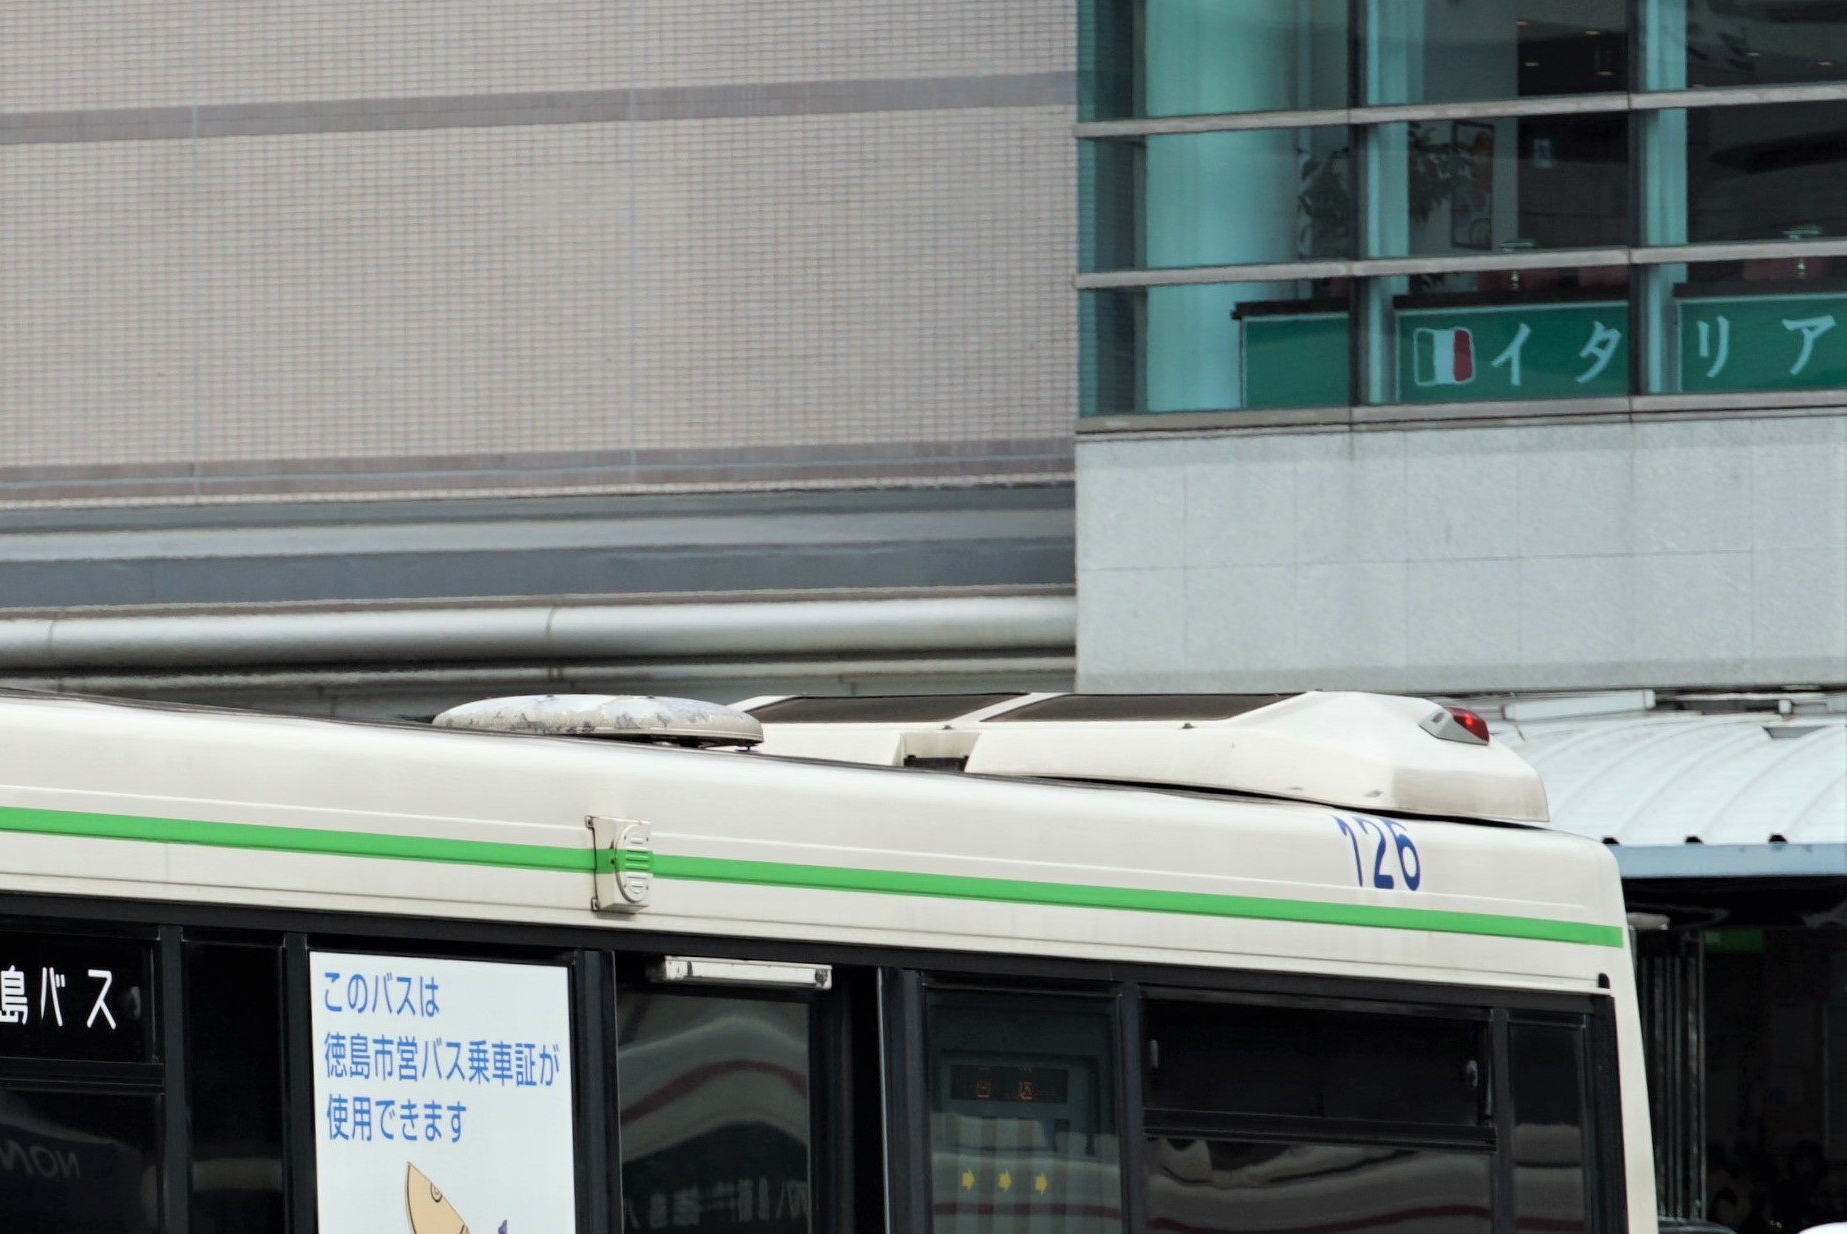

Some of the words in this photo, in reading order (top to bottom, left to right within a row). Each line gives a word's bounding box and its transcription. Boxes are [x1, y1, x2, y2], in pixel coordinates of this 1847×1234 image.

[1491, 314, 1839, 385] イタリア
[1332, 814, 1421, 891] 126
[323, 970, 440, 1018] このバスは
[324, 1031, 561, 1088] 徳島市営バス乗車証が
[326, 1093, 468, 1144] 使用できます
